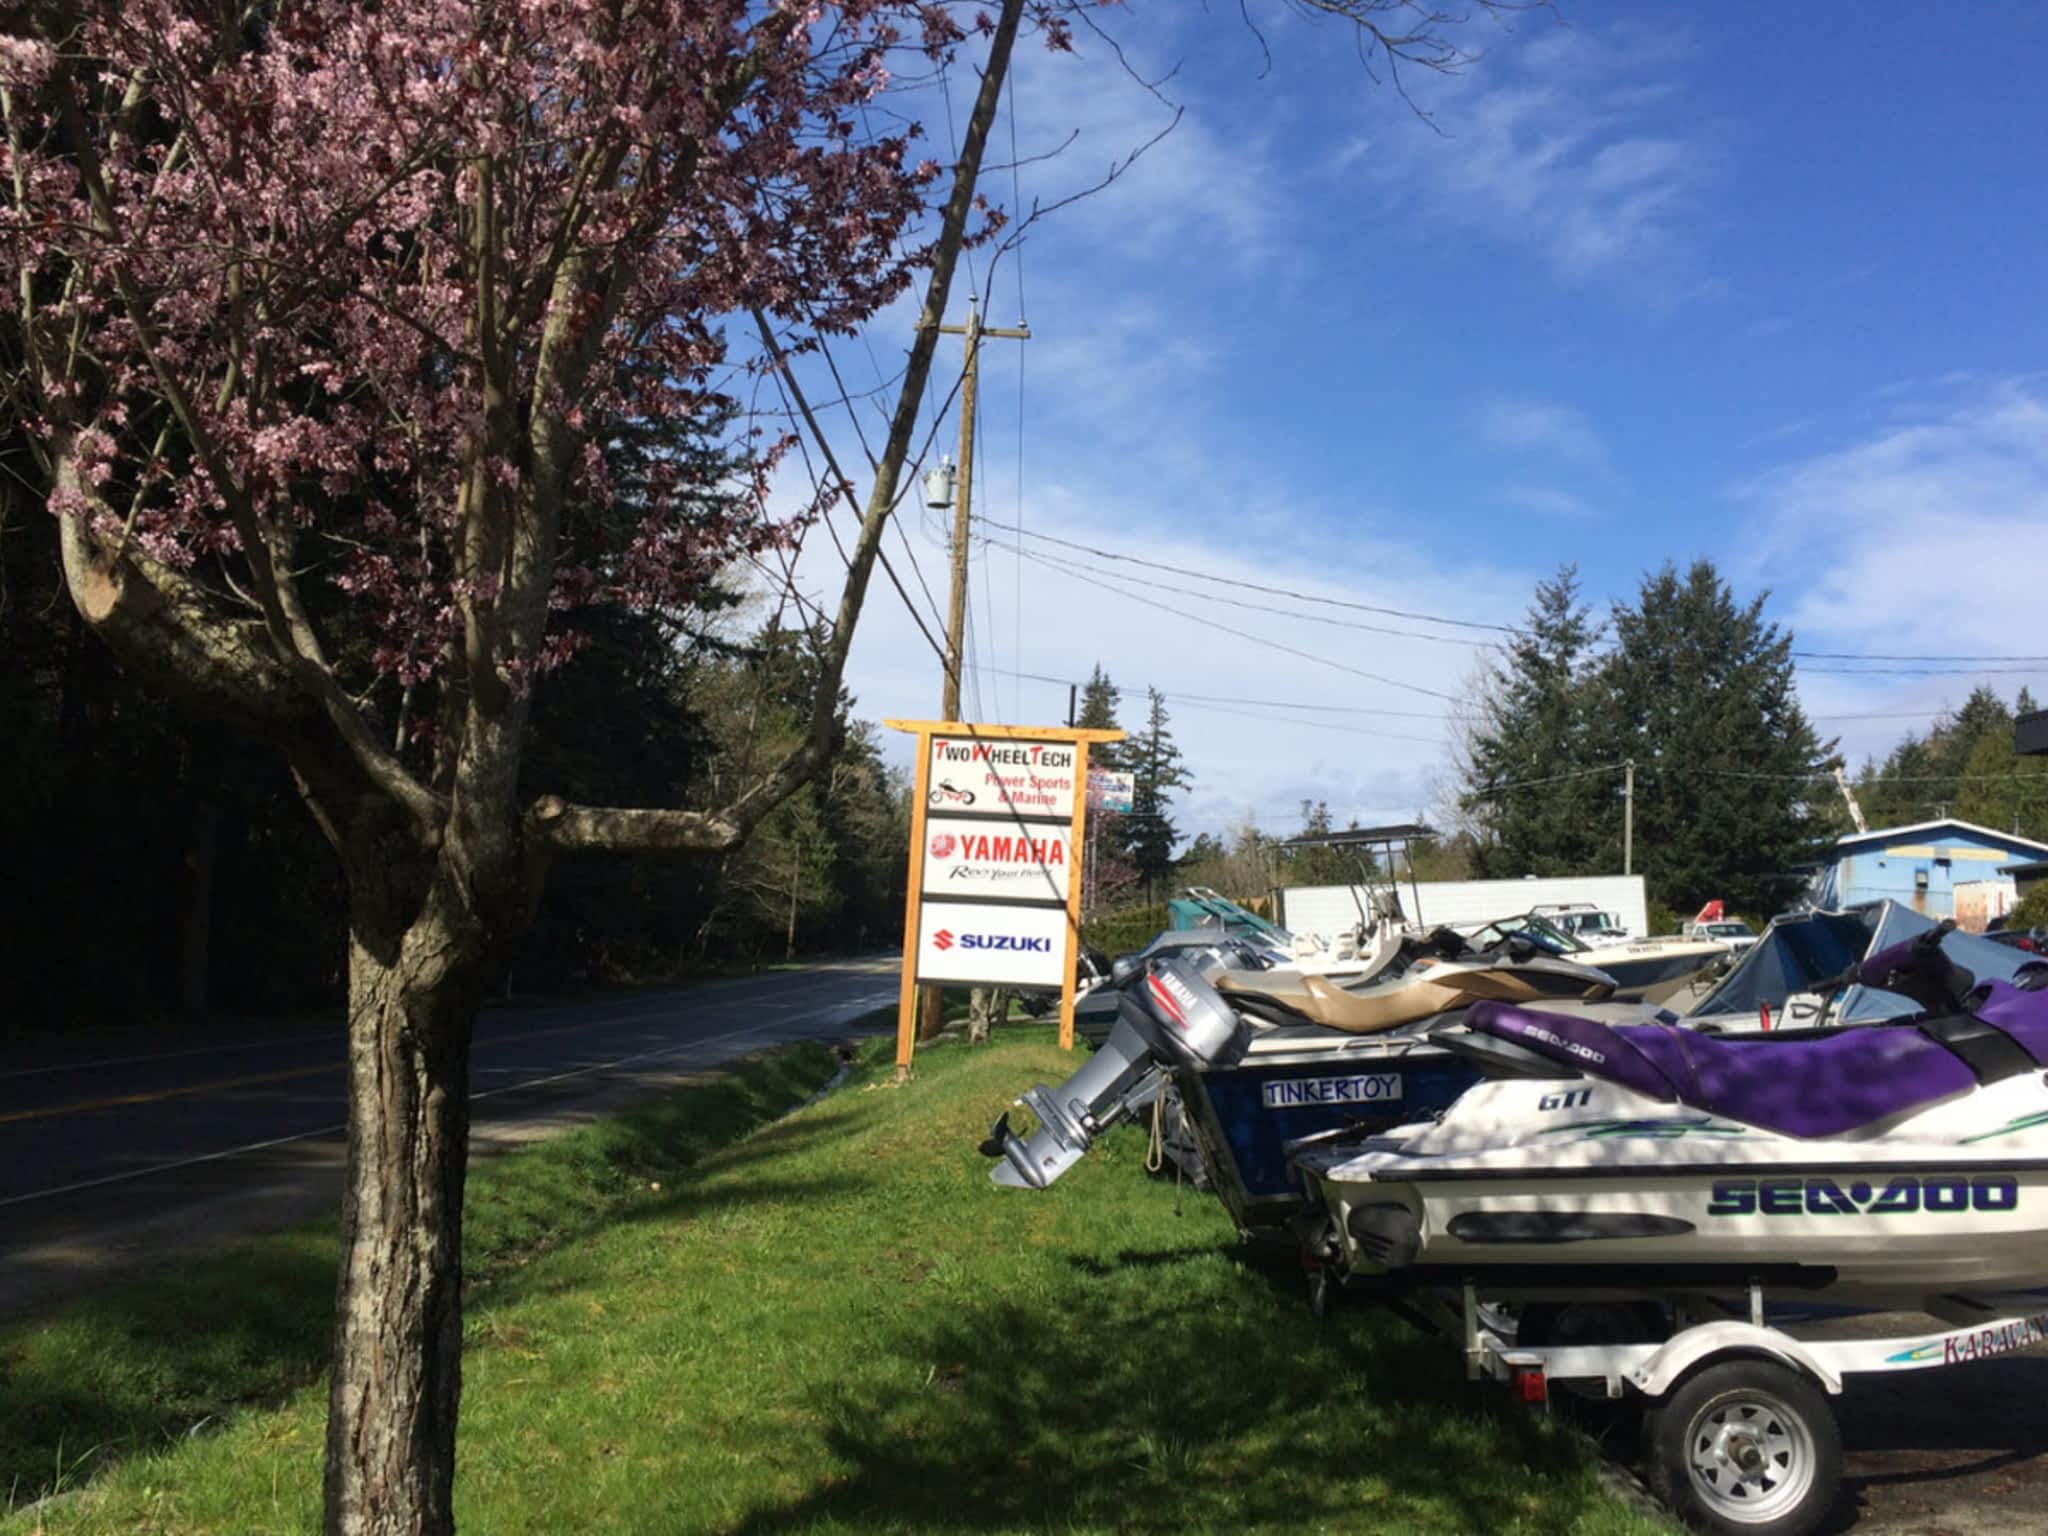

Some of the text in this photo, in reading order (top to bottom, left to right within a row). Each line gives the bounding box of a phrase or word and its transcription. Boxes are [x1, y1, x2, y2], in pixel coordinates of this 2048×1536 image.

[985, 773, 1072, 791] Power Sports
[1012, 791, 1057, 806] Marine
[960, 833, 1064, 865] YAMAHA
[960, 933, 1052, 953] SUZUKI
[1266, 1075, 1398, 1105] TINKERTOY
